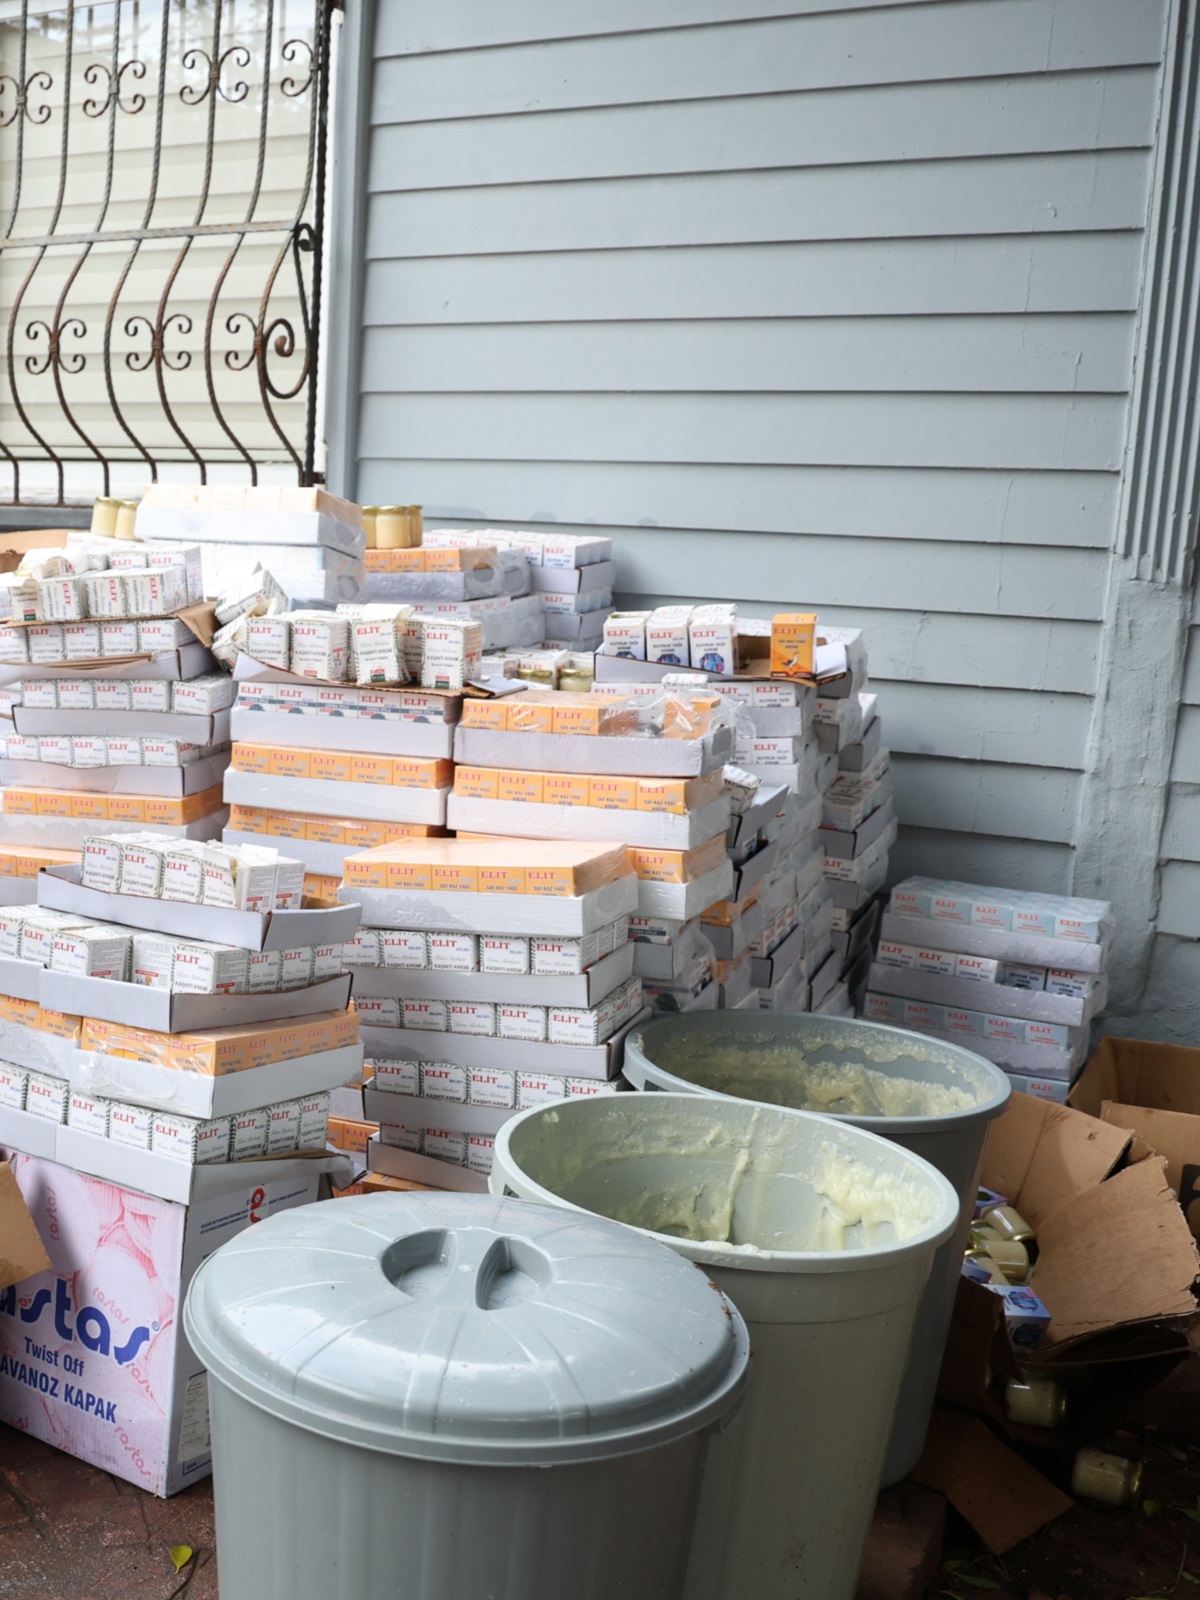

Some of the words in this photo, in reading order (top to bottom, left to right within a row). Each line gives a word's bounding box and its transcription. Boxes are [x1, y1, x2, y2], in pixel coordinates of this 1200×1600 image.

[385, 939, 408, 947] ELİT
[432, 940, 456, 948] ELİT
[536, 944, 563, 952] ELİT
[358, 1002, 382, 1011] ELİT
[406, 1004, 429, 1013] ELİT
[452, 1006, 477, 1015] ELİT
[502, 1009, 528, 1018] ELİT
[553, 1015, 580, 1023] ELİT
[378, 1066, 402, 1074] ELİT
[425, 1069, 450, 1078] ELİT
[472, 1074, 498, 1084] ELİT
[522, 1080, 548, 1090] ELİT
[93, 1286, 129, 1325] rastas
[24, 1337, 59, 1366] Twist
[63, 1355, 85, 1378] Off
[64, 1383, 117, 1424] KAPAK
[115, 1426, 151, 1476] rastas
